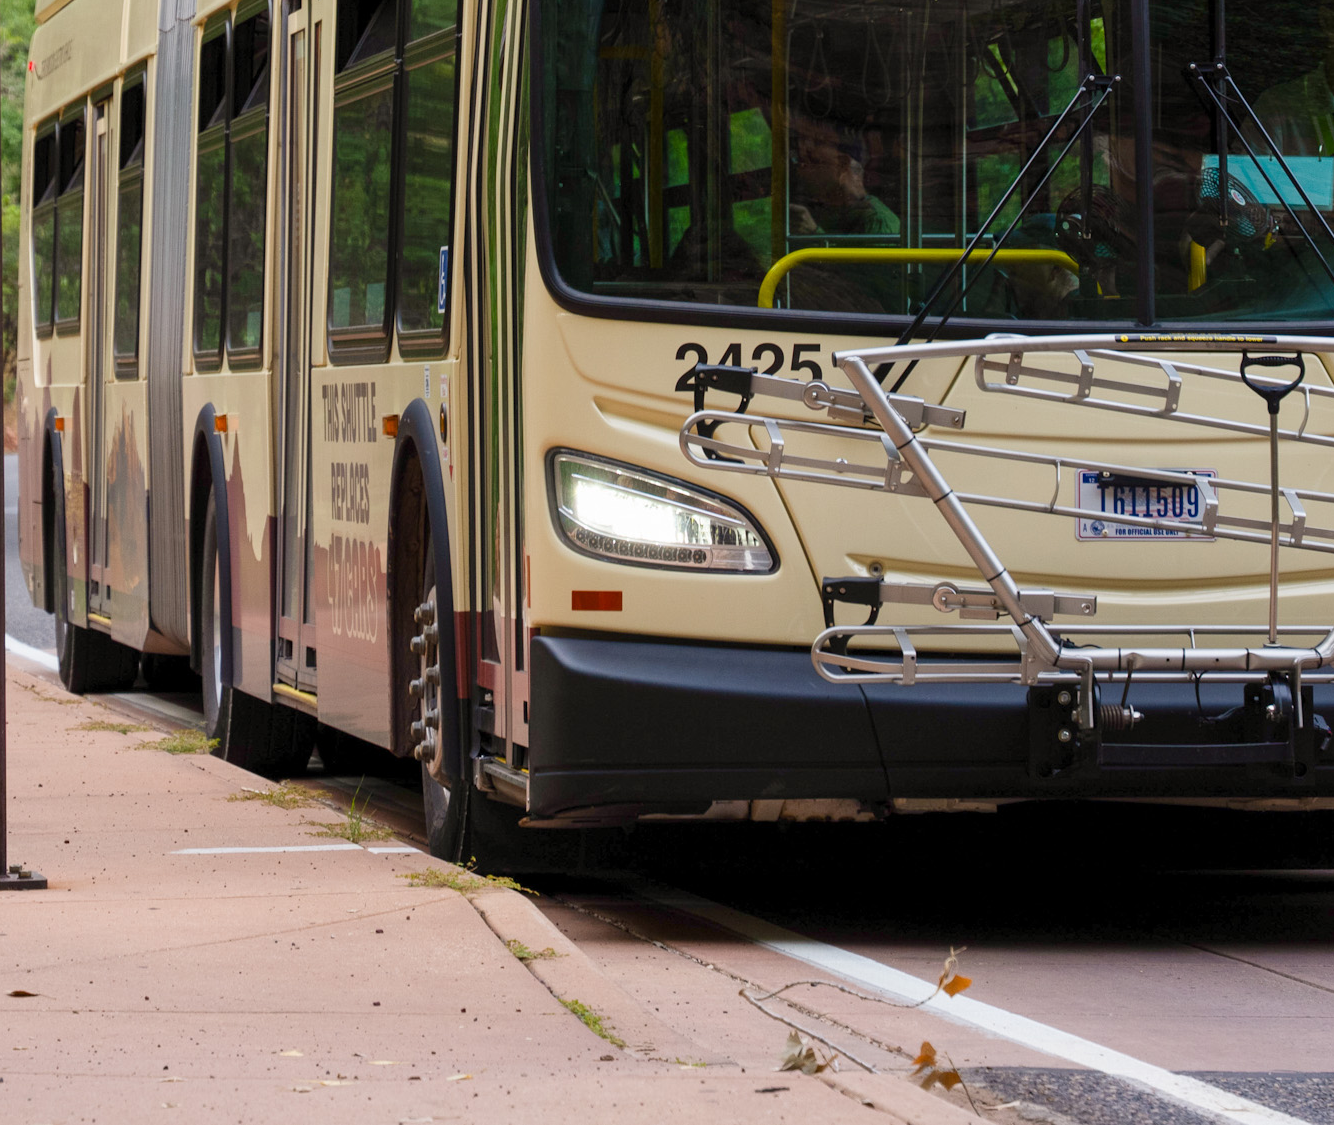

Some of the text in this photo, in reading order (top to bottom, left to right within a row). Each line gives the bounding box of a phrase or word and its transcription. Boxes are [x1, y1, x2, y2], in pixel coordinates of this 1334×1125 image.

[322, 382, 377, 443] THIS SHUTTLE
[331, 462, 370, 525] REPLACES
[1115, 528, 1126, 536] FOR
[1127, 528, 1152, 536] OFFICIAL
[1153, 528, 1164, 536] USE
[344, 536, 378, 644] CARS
